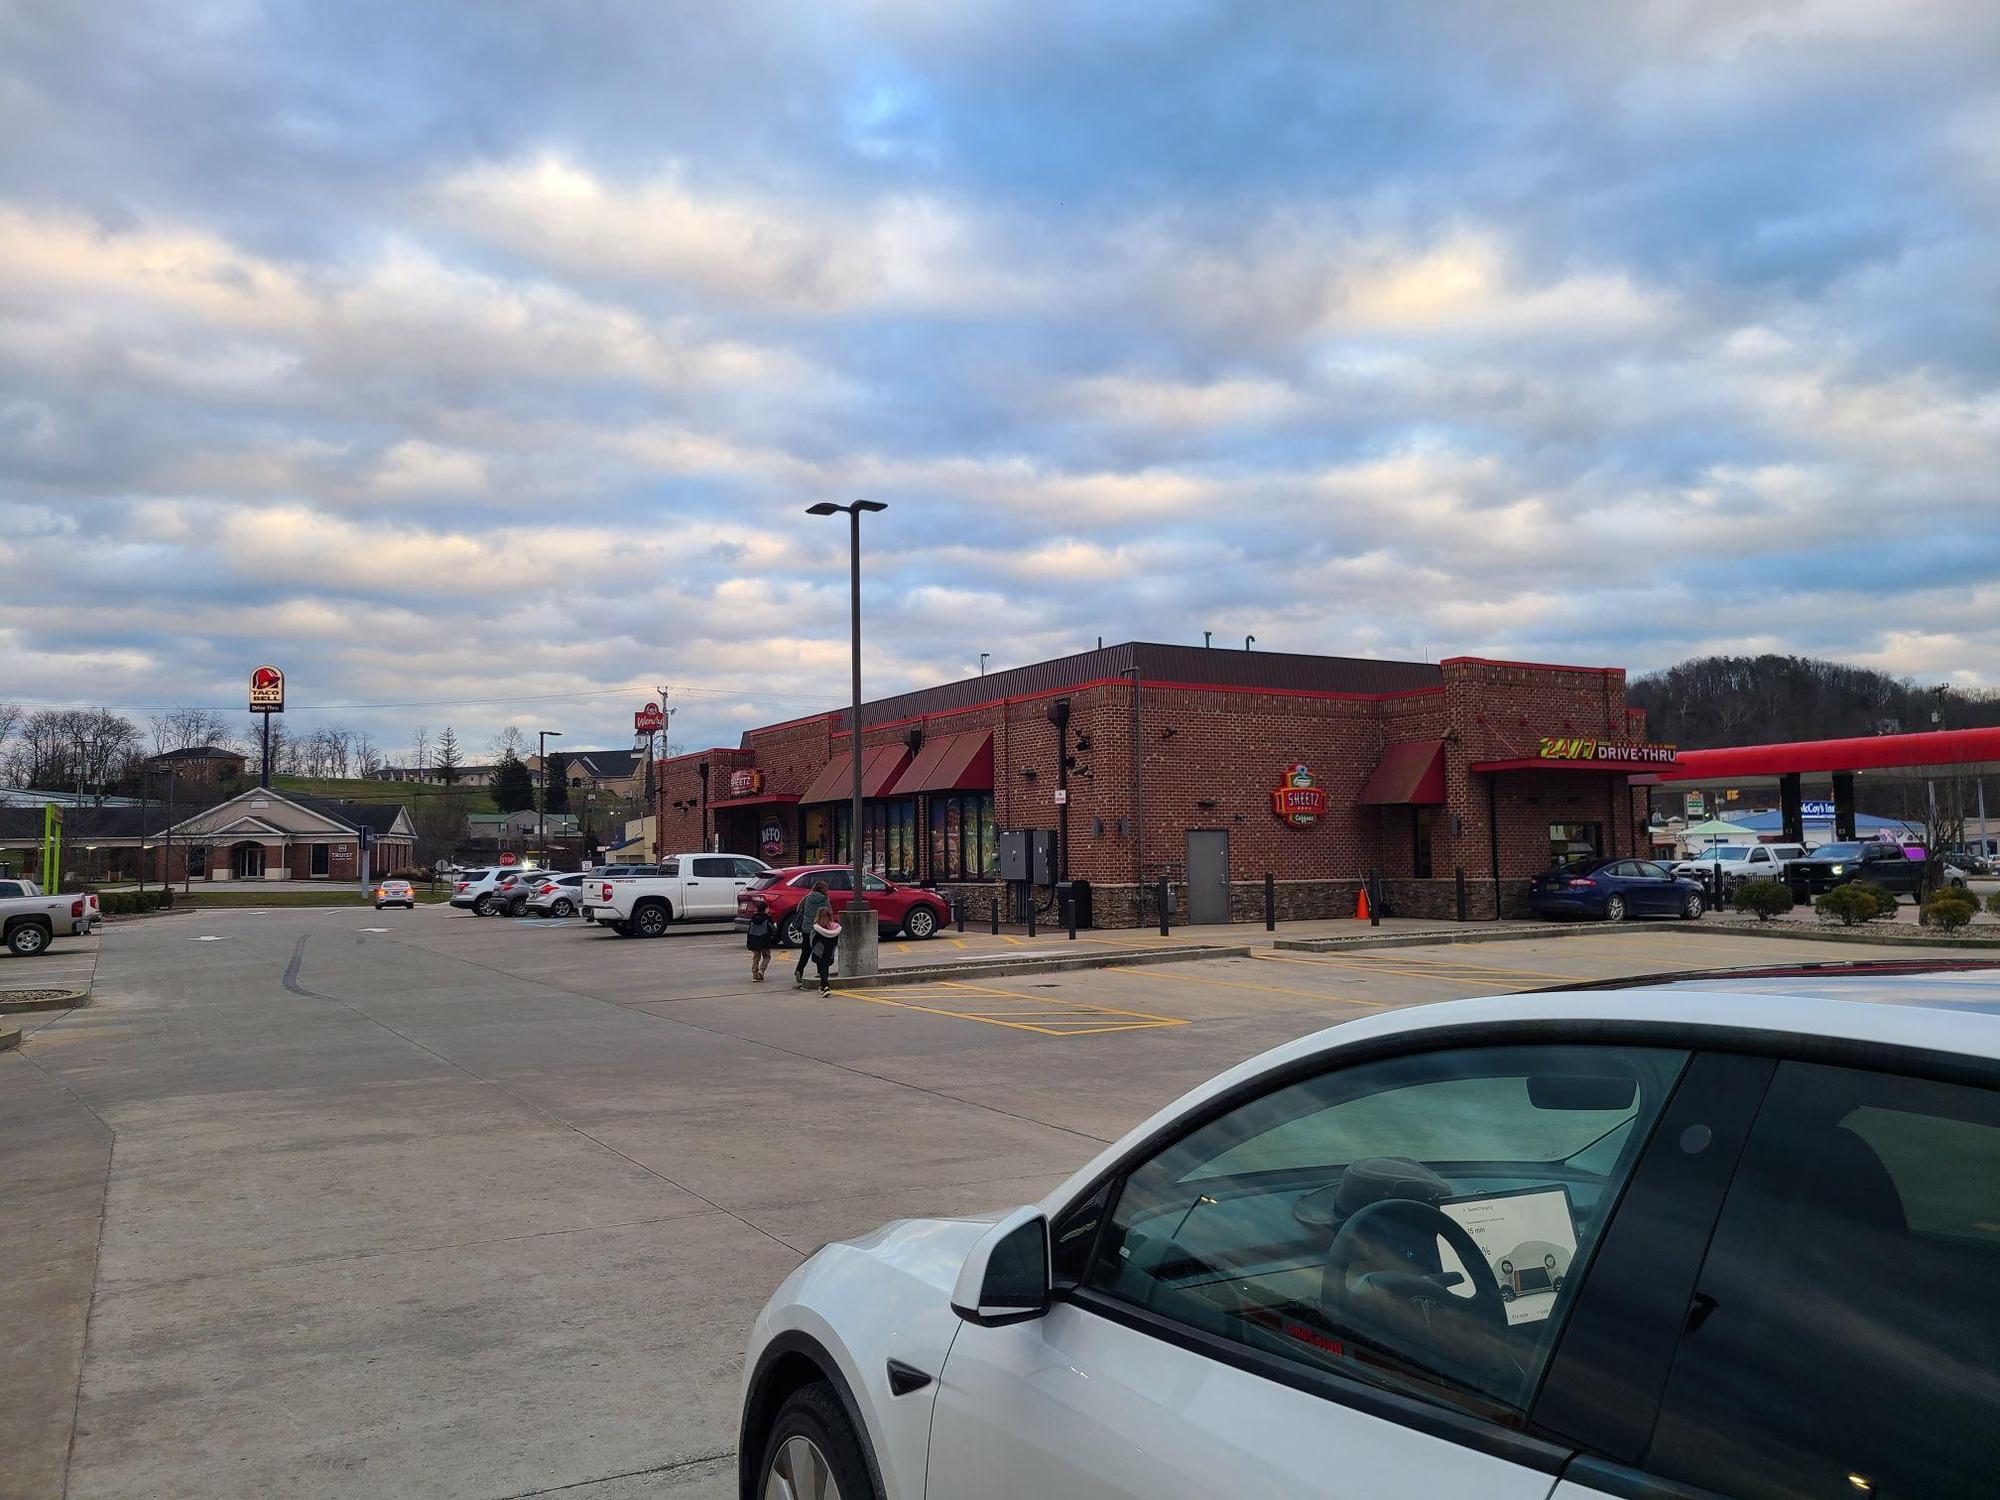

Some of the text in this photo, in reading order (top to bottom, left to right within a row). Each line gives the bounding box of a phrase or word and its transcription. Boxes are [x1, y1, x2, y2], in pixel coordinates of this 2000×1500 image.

[637, 716, 667, 727] Wendy
[1541, 737, 1596, 759] 24/7
[1598, 746, 1676, 762] DRIVE-THRU
[1288, 792, 1319, 807] SHEETZ
